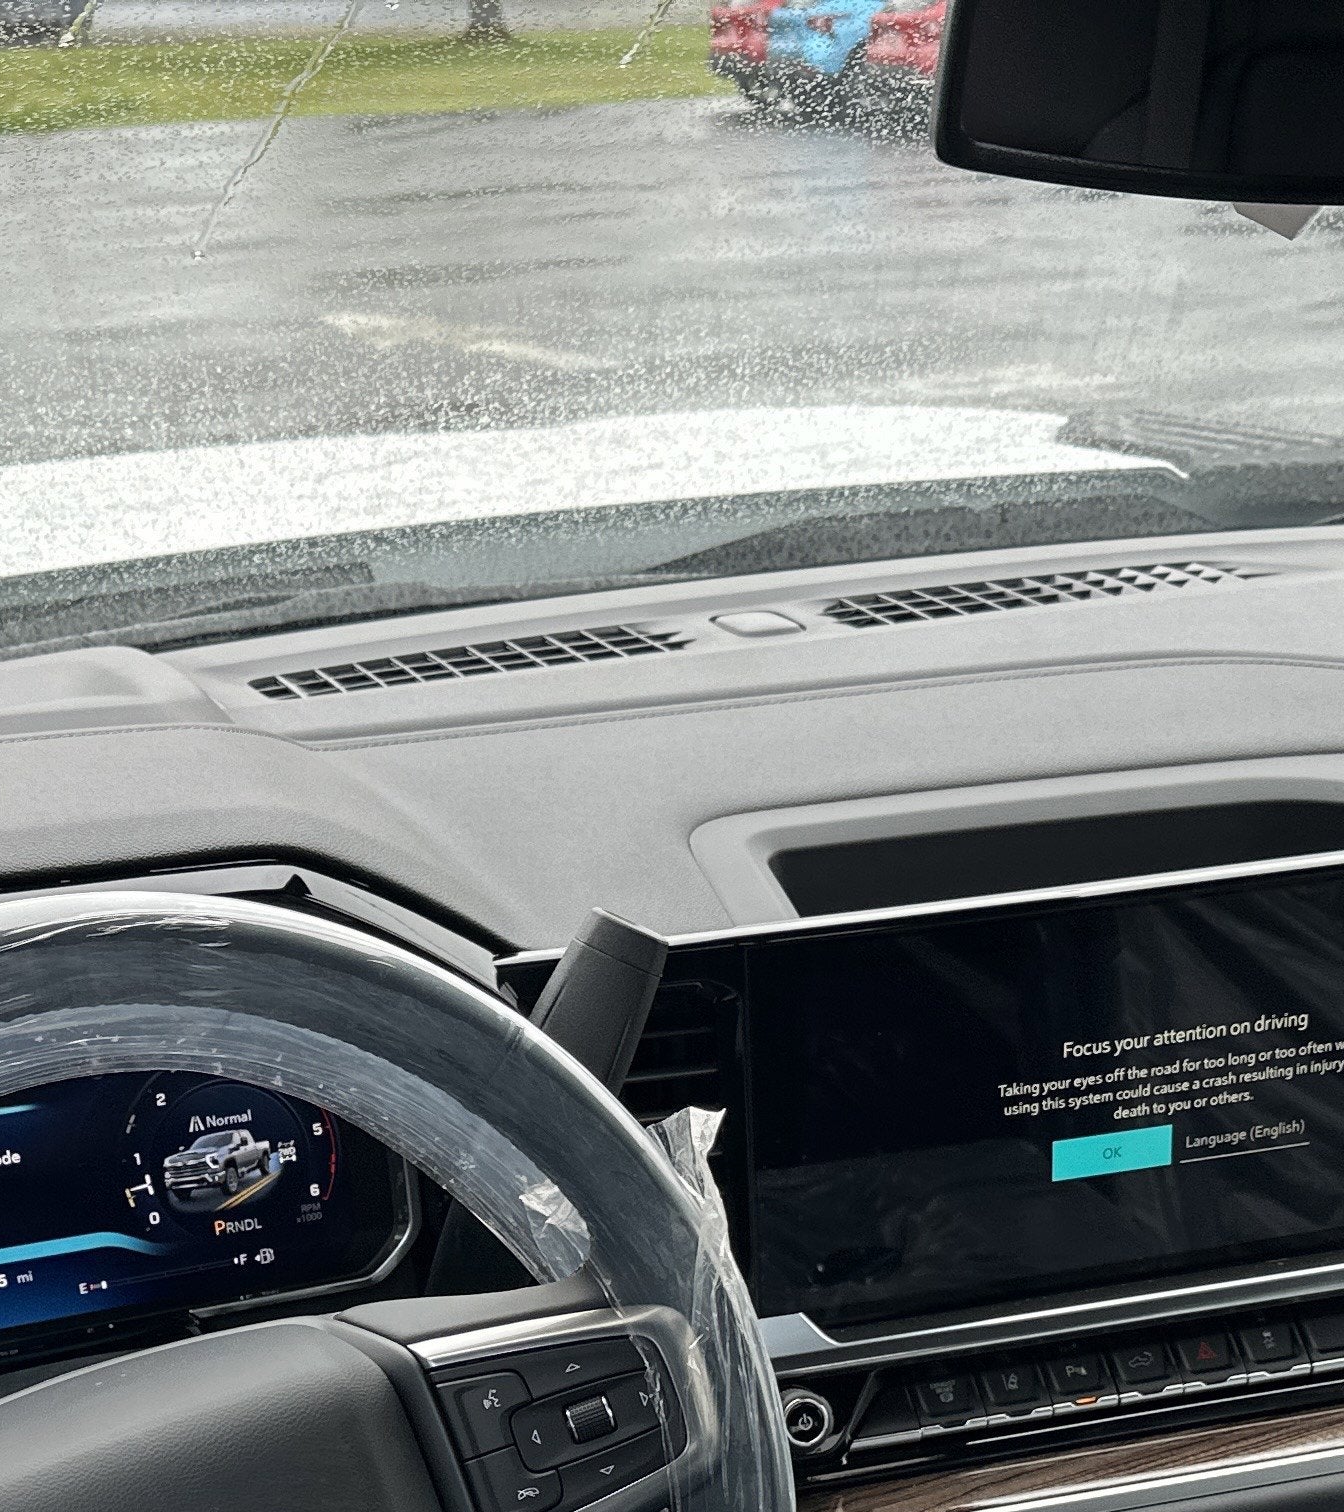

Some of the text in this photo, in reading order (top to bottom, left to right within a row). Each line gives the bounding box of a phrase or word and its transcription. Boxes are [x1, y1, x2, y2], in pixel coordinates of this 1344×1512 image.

[1062, 1012, 1308, 1058] Focus your attention on driving
[997, 1081, 1040, 1097] Taking
[1041, 1078, 1072, 1095] your
[1072, 1074, 1103, 1090] eyes
[1104, 1066, 1126, 1083] off
[1126, 1065, 1148, 1080] the
[1150, 1059, 1180, 1076] road
[1181, 1057, 1202, 1072] for
[1202, 1057, 1225, 1069] too
[1227, 1052, 1256, 1067] long
[1257, 1050, 1273, 1061] or
[1274, 1047, 1296, 1059] too
[1297, 1040, 1332, 1056] often
[1003, 1101, 1039, 1116] using
[1040, 1096, 1066, 1111] this
[1067, 1091, 1113, 1110] system
[1115, 1082, 1151, 1100] could
[1152, 1080, 1190, 1095] cause
[1191, 1079, 1200, 1090] a
[1201, 1071, 1237, 1088] crash
[1238, 1065, 1293, 1083] resulting
[1295, 1062, 1308, 1074] in
[1309, 1058, 1344, 1075] injury
[156, 1093, 166, 1106] 2
[1112, 1090, 1254, 1119] death to you or others.
[206, 1109, 252, 1128] Normal
[312, 1123, 323, 1136] 5
[1185, 1118, 1305, 1148] Language (English)
[133, 1153, 141, 1166] 1
[1102, 1146, 1122, 1160] OK
[309, 1183, 320, 1196] 6
[149, 1211, 160, 1224] 0
[214, 1218, 262, 1236] PRNDL
[240, 1254, 248, 1265] F
[17, 1270, 34, 1284] mi
[79, 1283, 88, 1294] E
